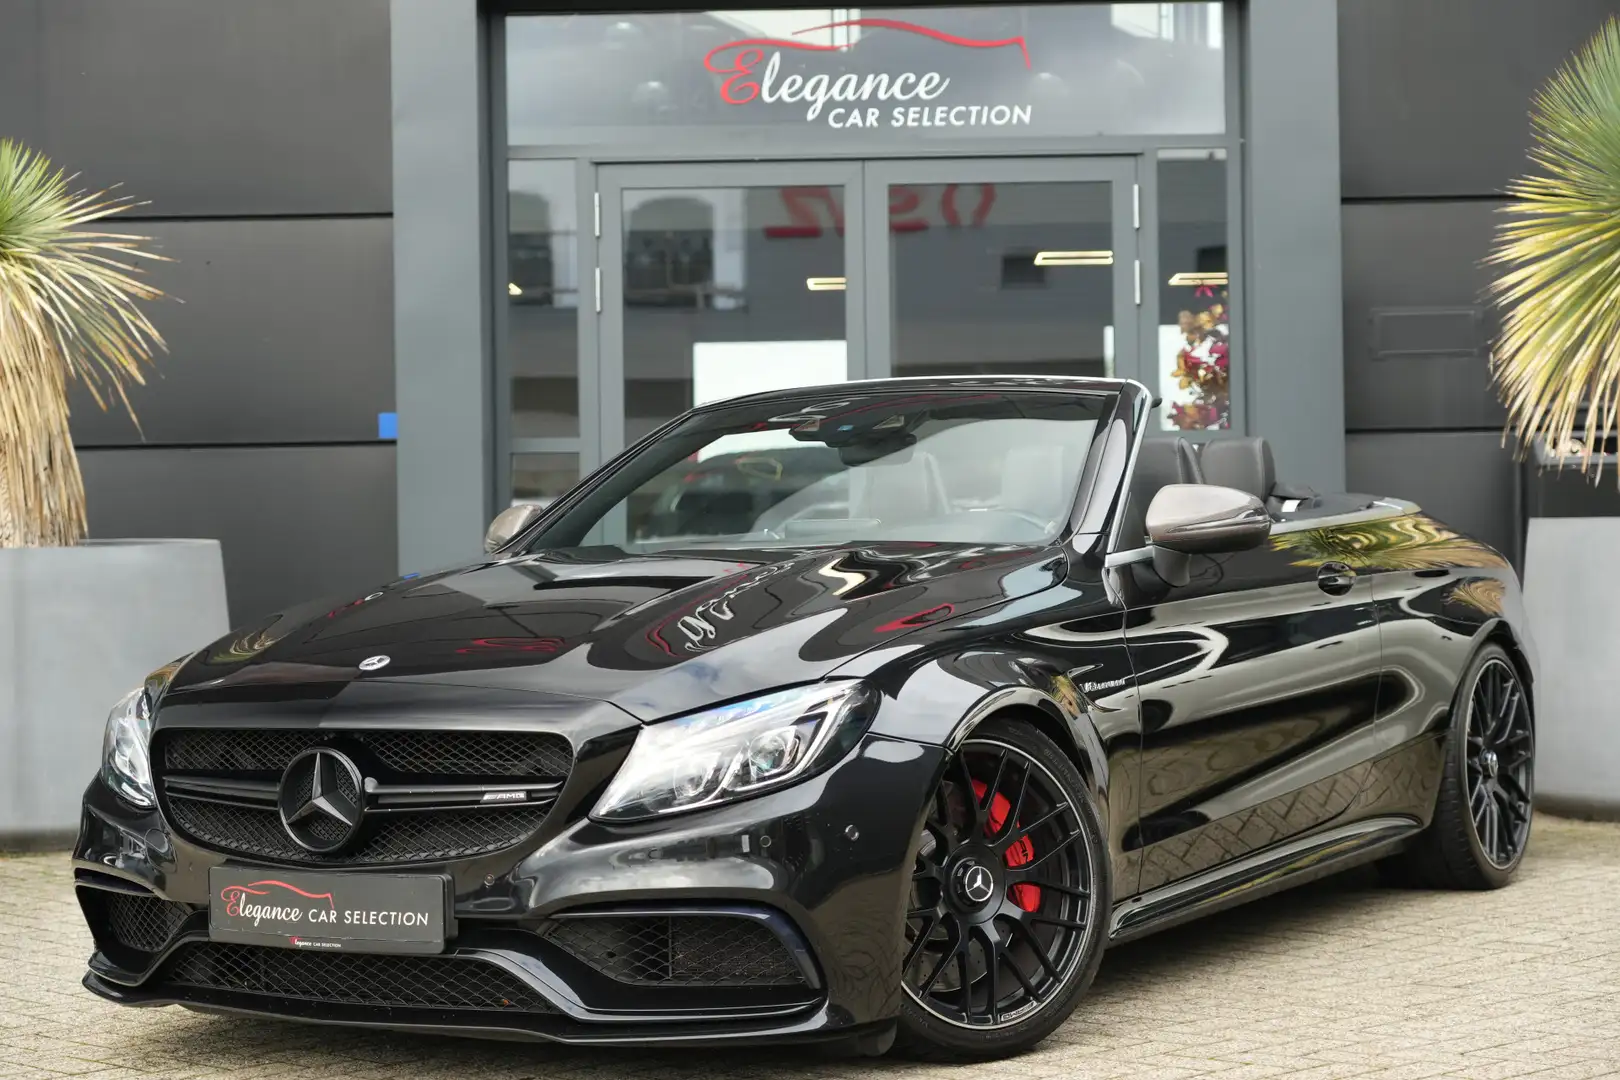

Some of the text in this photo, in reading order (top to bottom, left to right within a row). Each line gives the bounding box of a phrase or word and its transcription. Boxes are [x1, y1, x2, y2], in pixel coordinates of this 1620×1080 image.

[704, 43, 950, 121] Elegance
[828, 105, 1032, 128] CAR SELECTION
[221, 890, 429, 927] Elegance CAR SELECTION
